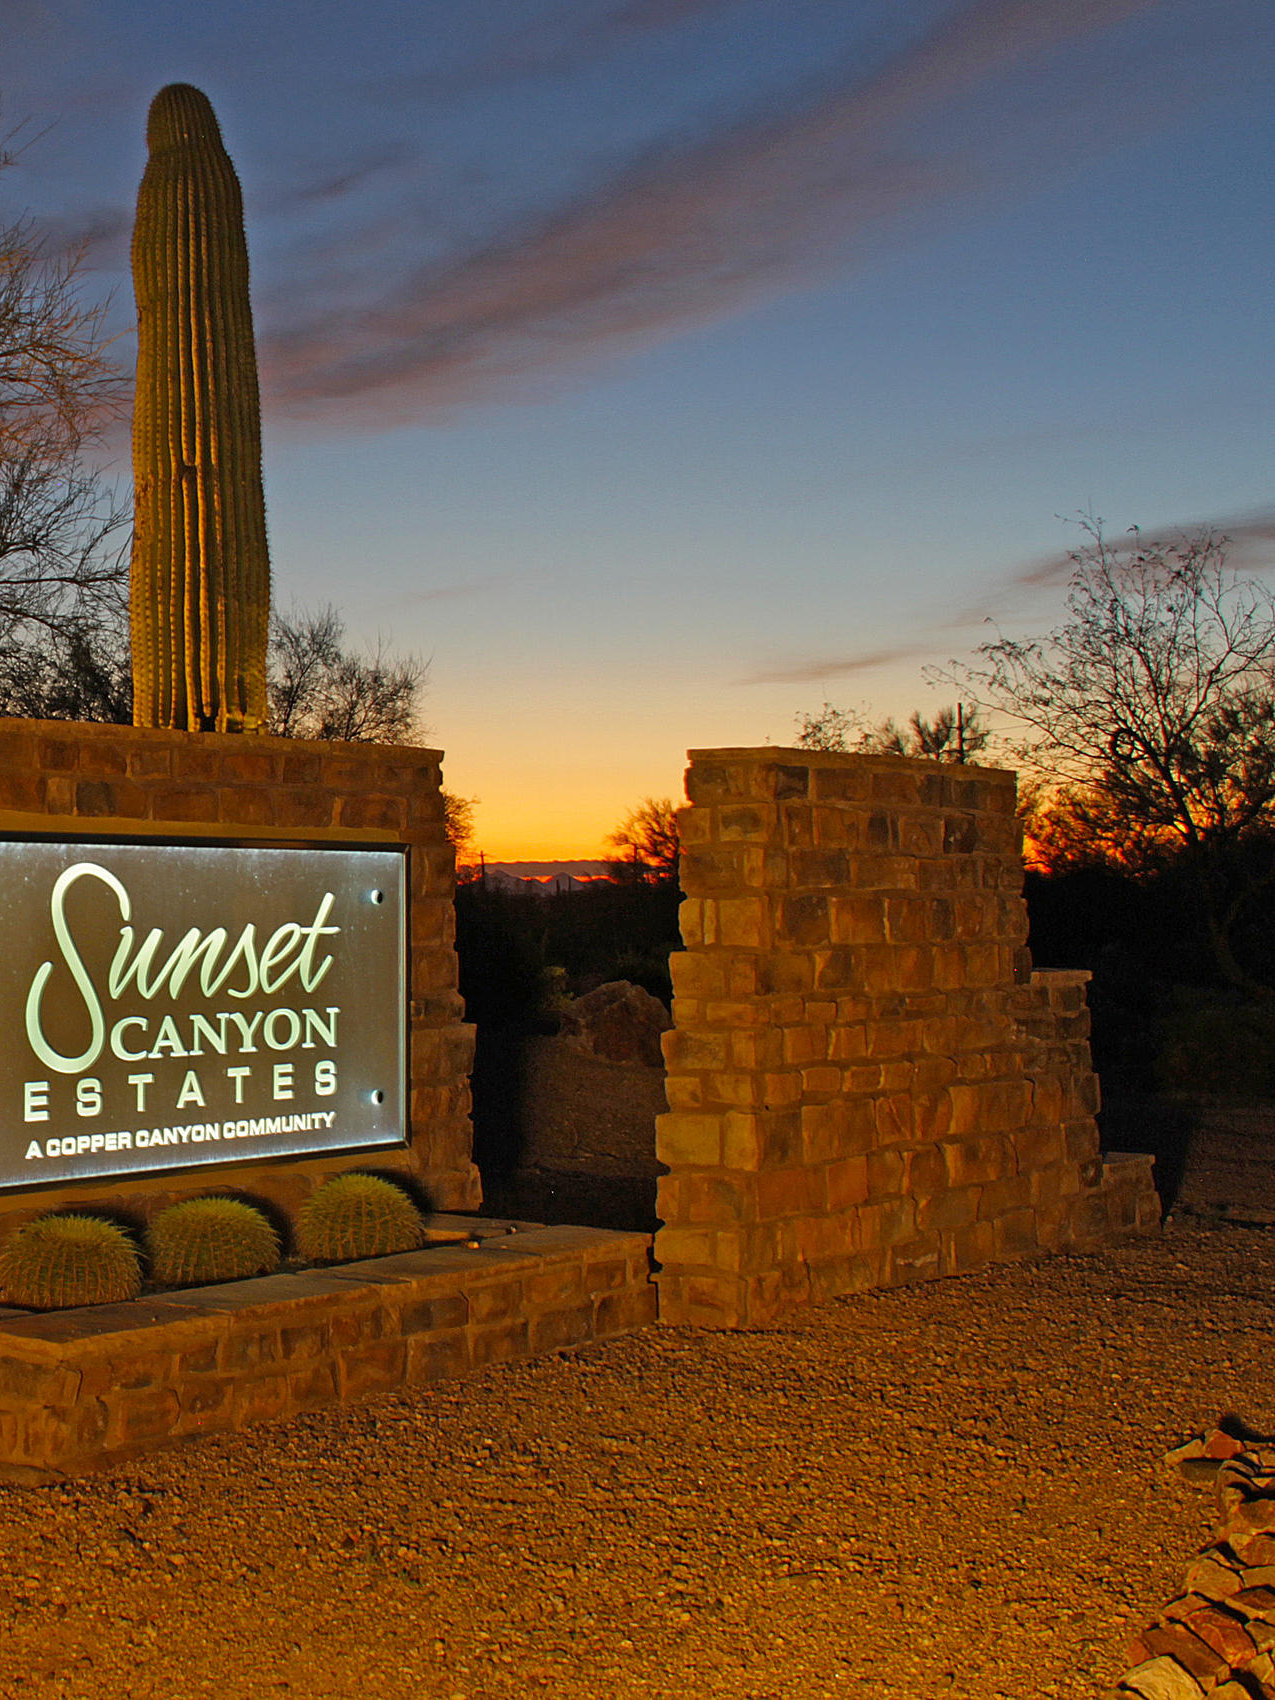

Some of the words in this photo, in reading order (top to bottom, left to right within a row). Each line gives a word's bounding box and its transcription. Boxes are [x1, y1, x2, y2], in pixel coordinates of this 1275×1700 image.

[25, 862, 341, 1074] Sunset
[110, 1007, 341, 1061] CANYON
[23, 1060, 338, 1122] ESTATES
[25, 1139, 44, 1160] A
[46, 1131, 132, 1158] COPPER
[135, 1123, 221, 1149] CANYON
[222, 1111, 337, 1139] COMMUNITY
